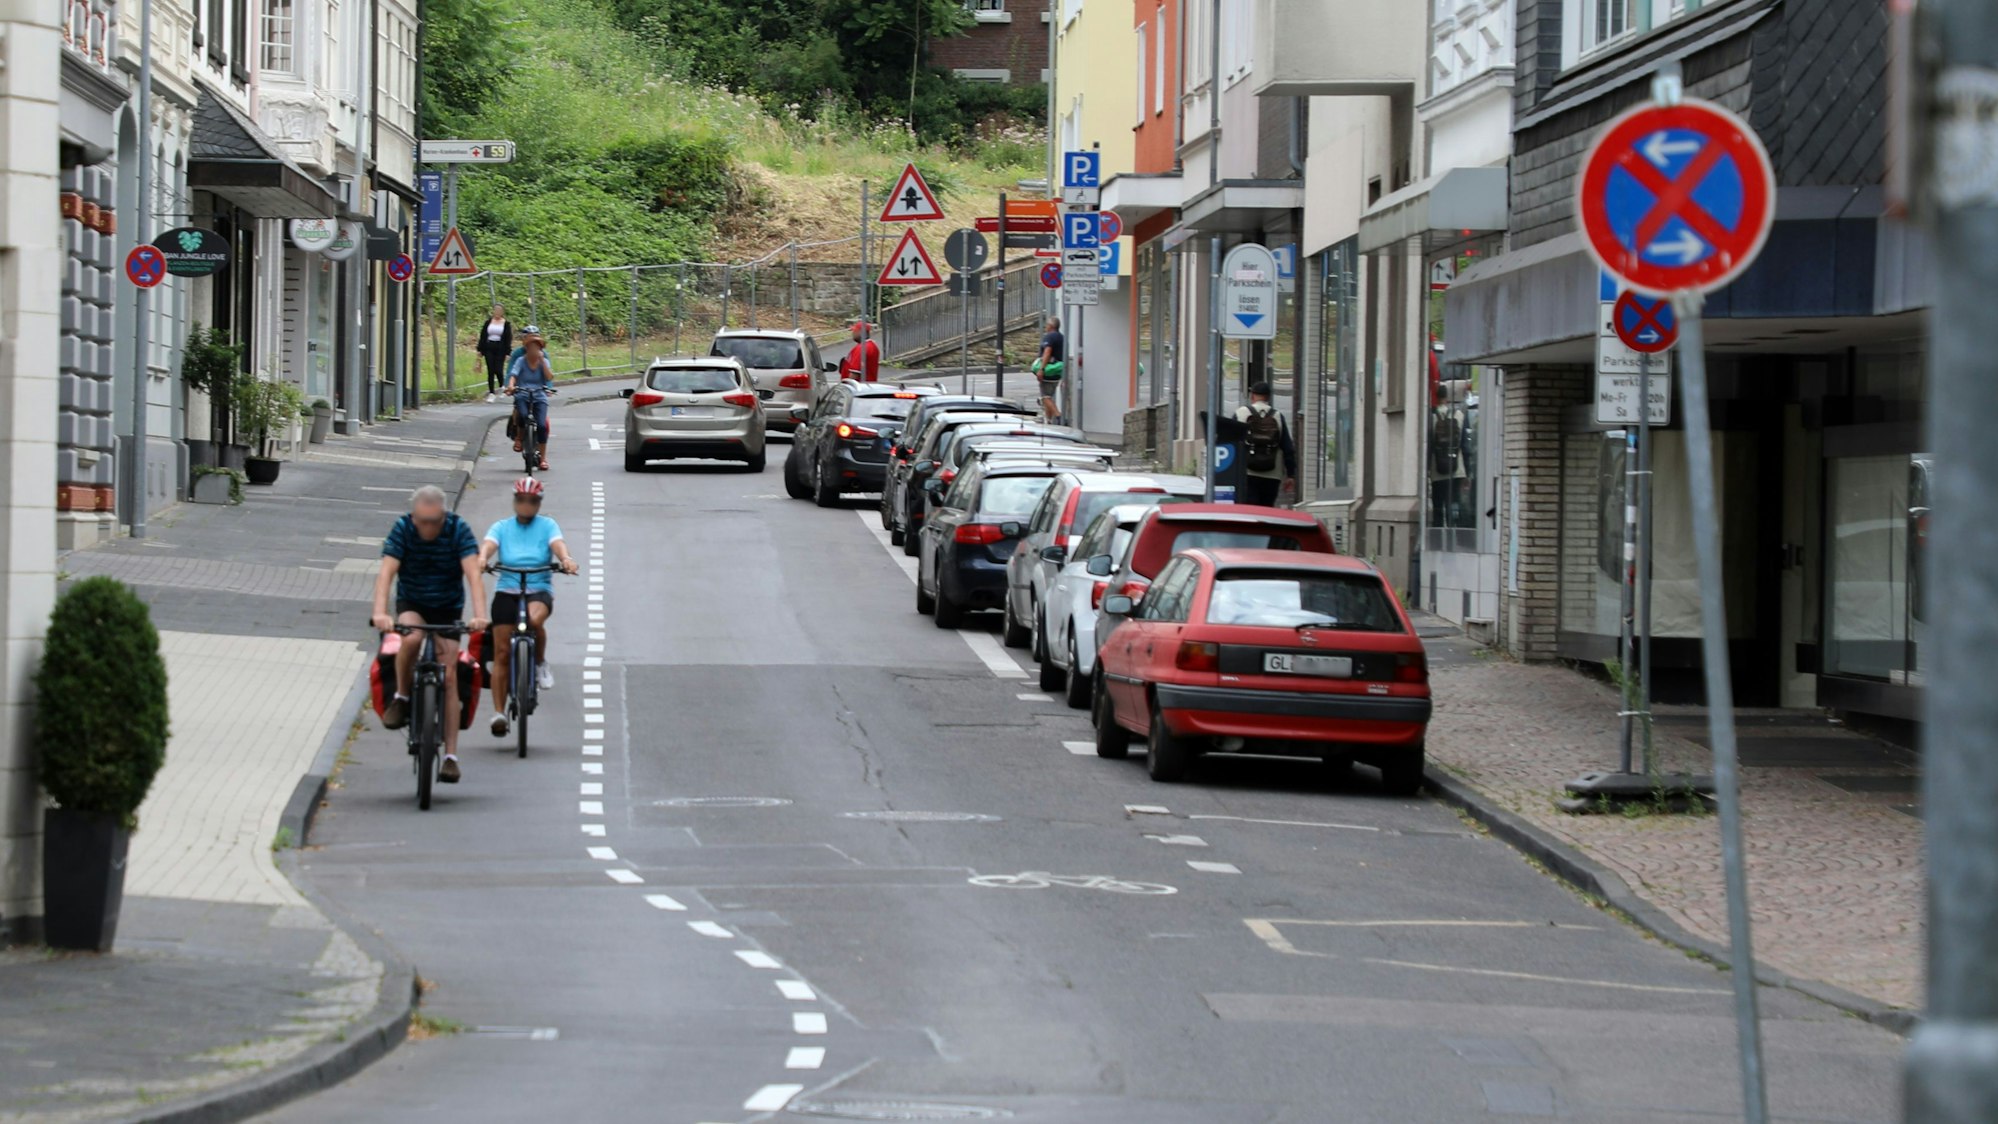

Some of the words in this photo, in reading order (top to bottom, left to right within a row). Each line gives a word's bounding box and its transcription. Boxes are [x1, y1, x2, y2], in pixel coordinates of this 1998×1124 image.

[490, 146, 505, 157] 59
[1072, 156, 1092, 184] P
[1072, 217, 1092, 245] P
[180, 252, 206, 260] JUNGLE
[1228, 278, 1272, 287] Parkschein
[1603, 356, 1665, 367] Parkscein
[1613, 376, 1655, 387] werkts
[1600, 391, 1627, 403] Mo-Fr
[1616, 406, 1627, 417] Sa
[1215, 446, 1229, 467] P
[1270, 655, 1289, 672] GL
